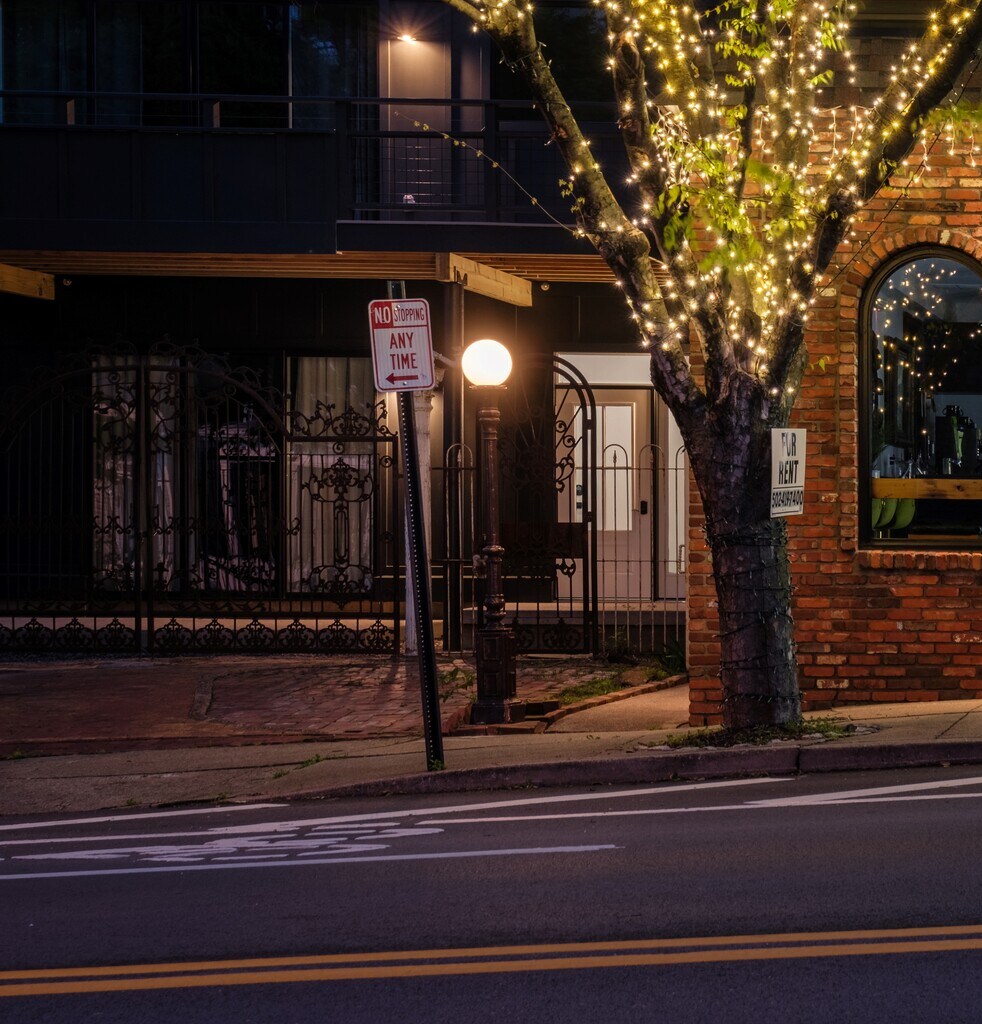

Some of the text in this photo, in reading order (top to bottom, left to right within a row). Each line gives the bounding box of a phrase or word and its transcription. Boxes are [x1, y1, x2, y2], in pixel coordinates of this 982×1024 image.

[374, 306, 425, 324] NO STOPPING
[390, 332, 414, 349] ANY
[390, 353, 418, 370] TIME
[779, 460, 798, 484] RENT
